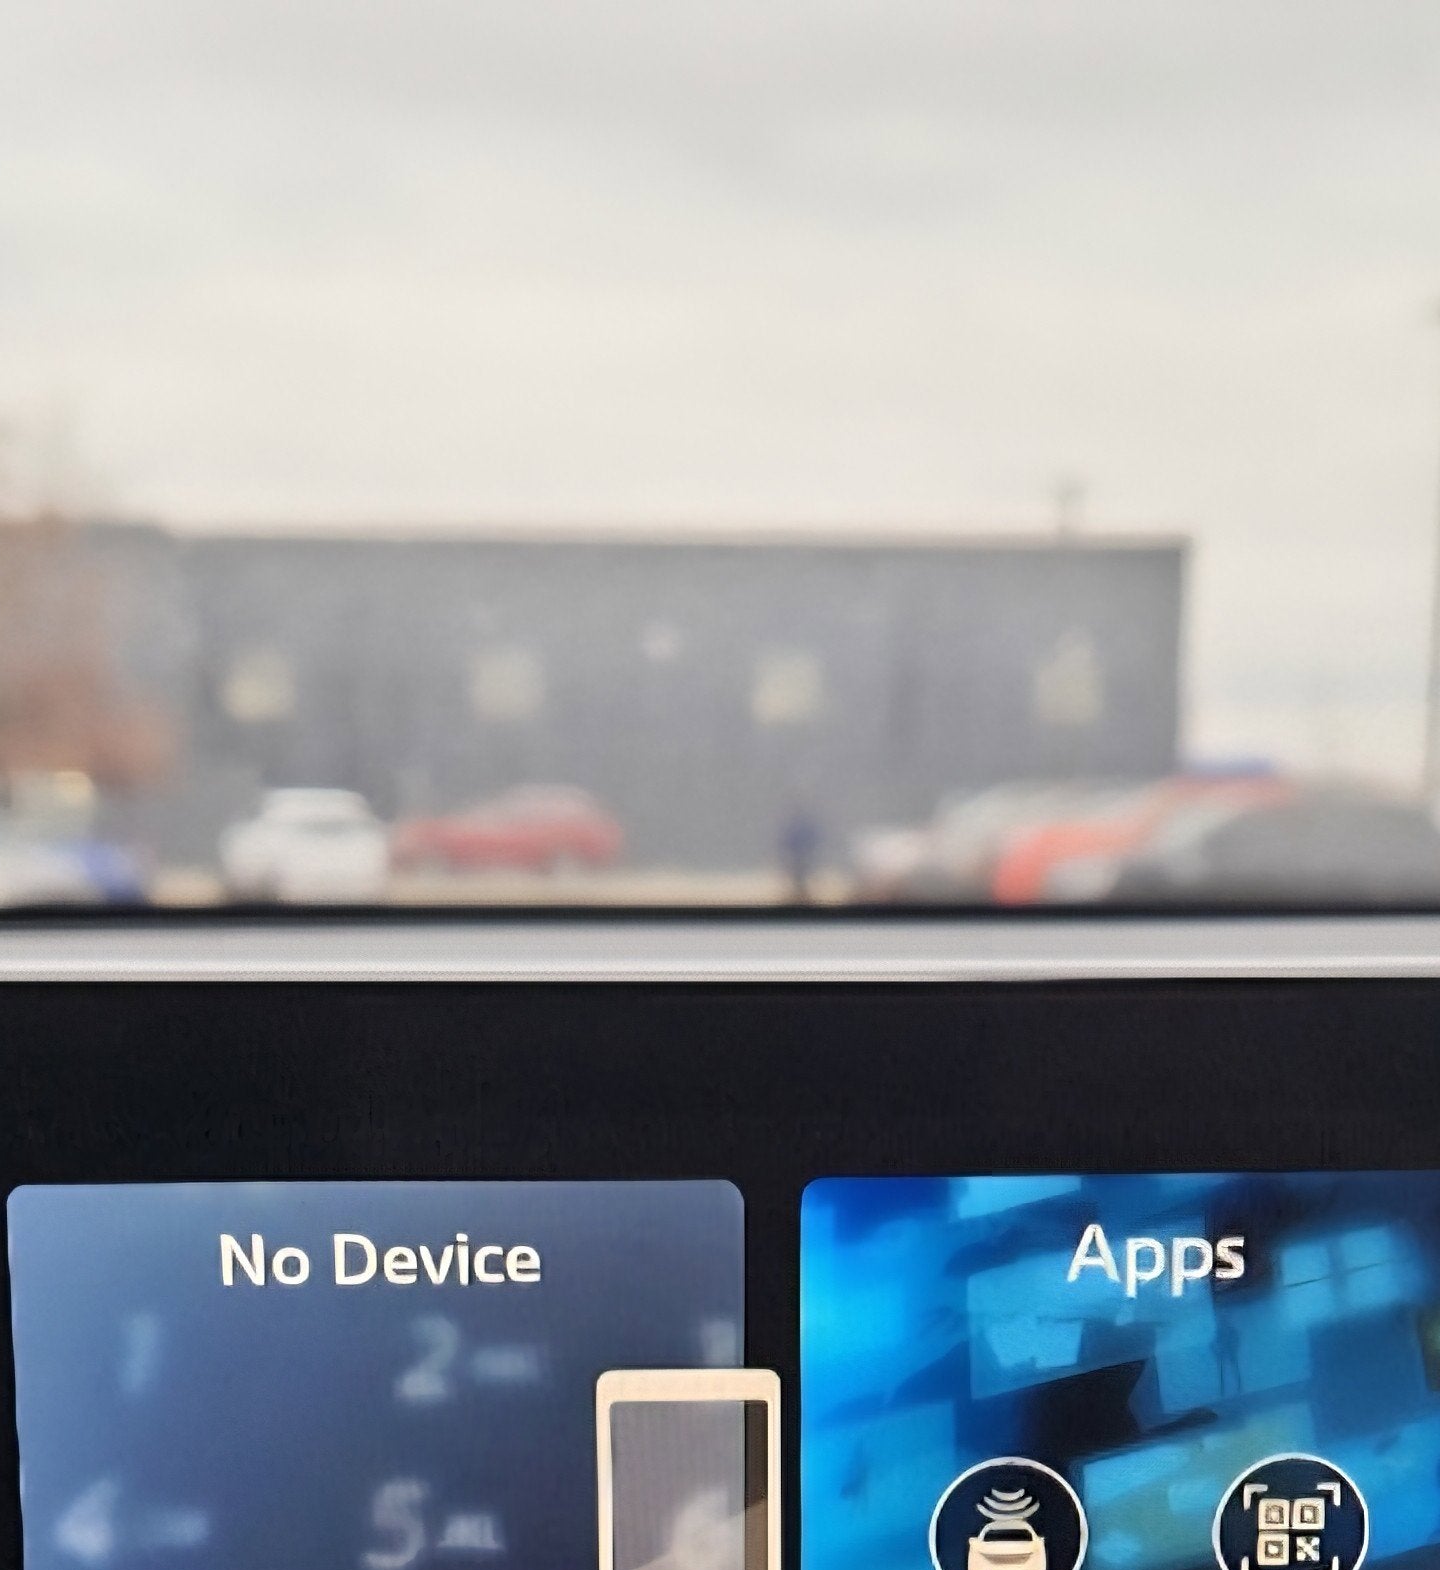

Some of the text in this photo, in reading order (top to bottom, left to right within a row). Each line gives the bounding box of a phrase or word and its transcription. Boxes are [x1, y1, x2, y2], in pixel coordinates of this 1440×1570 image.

[220, 1231, 542, 1287] No Device
[1066, 1224, 1247, 1296] Apps
[366, 1480, 425, 1570] 5
